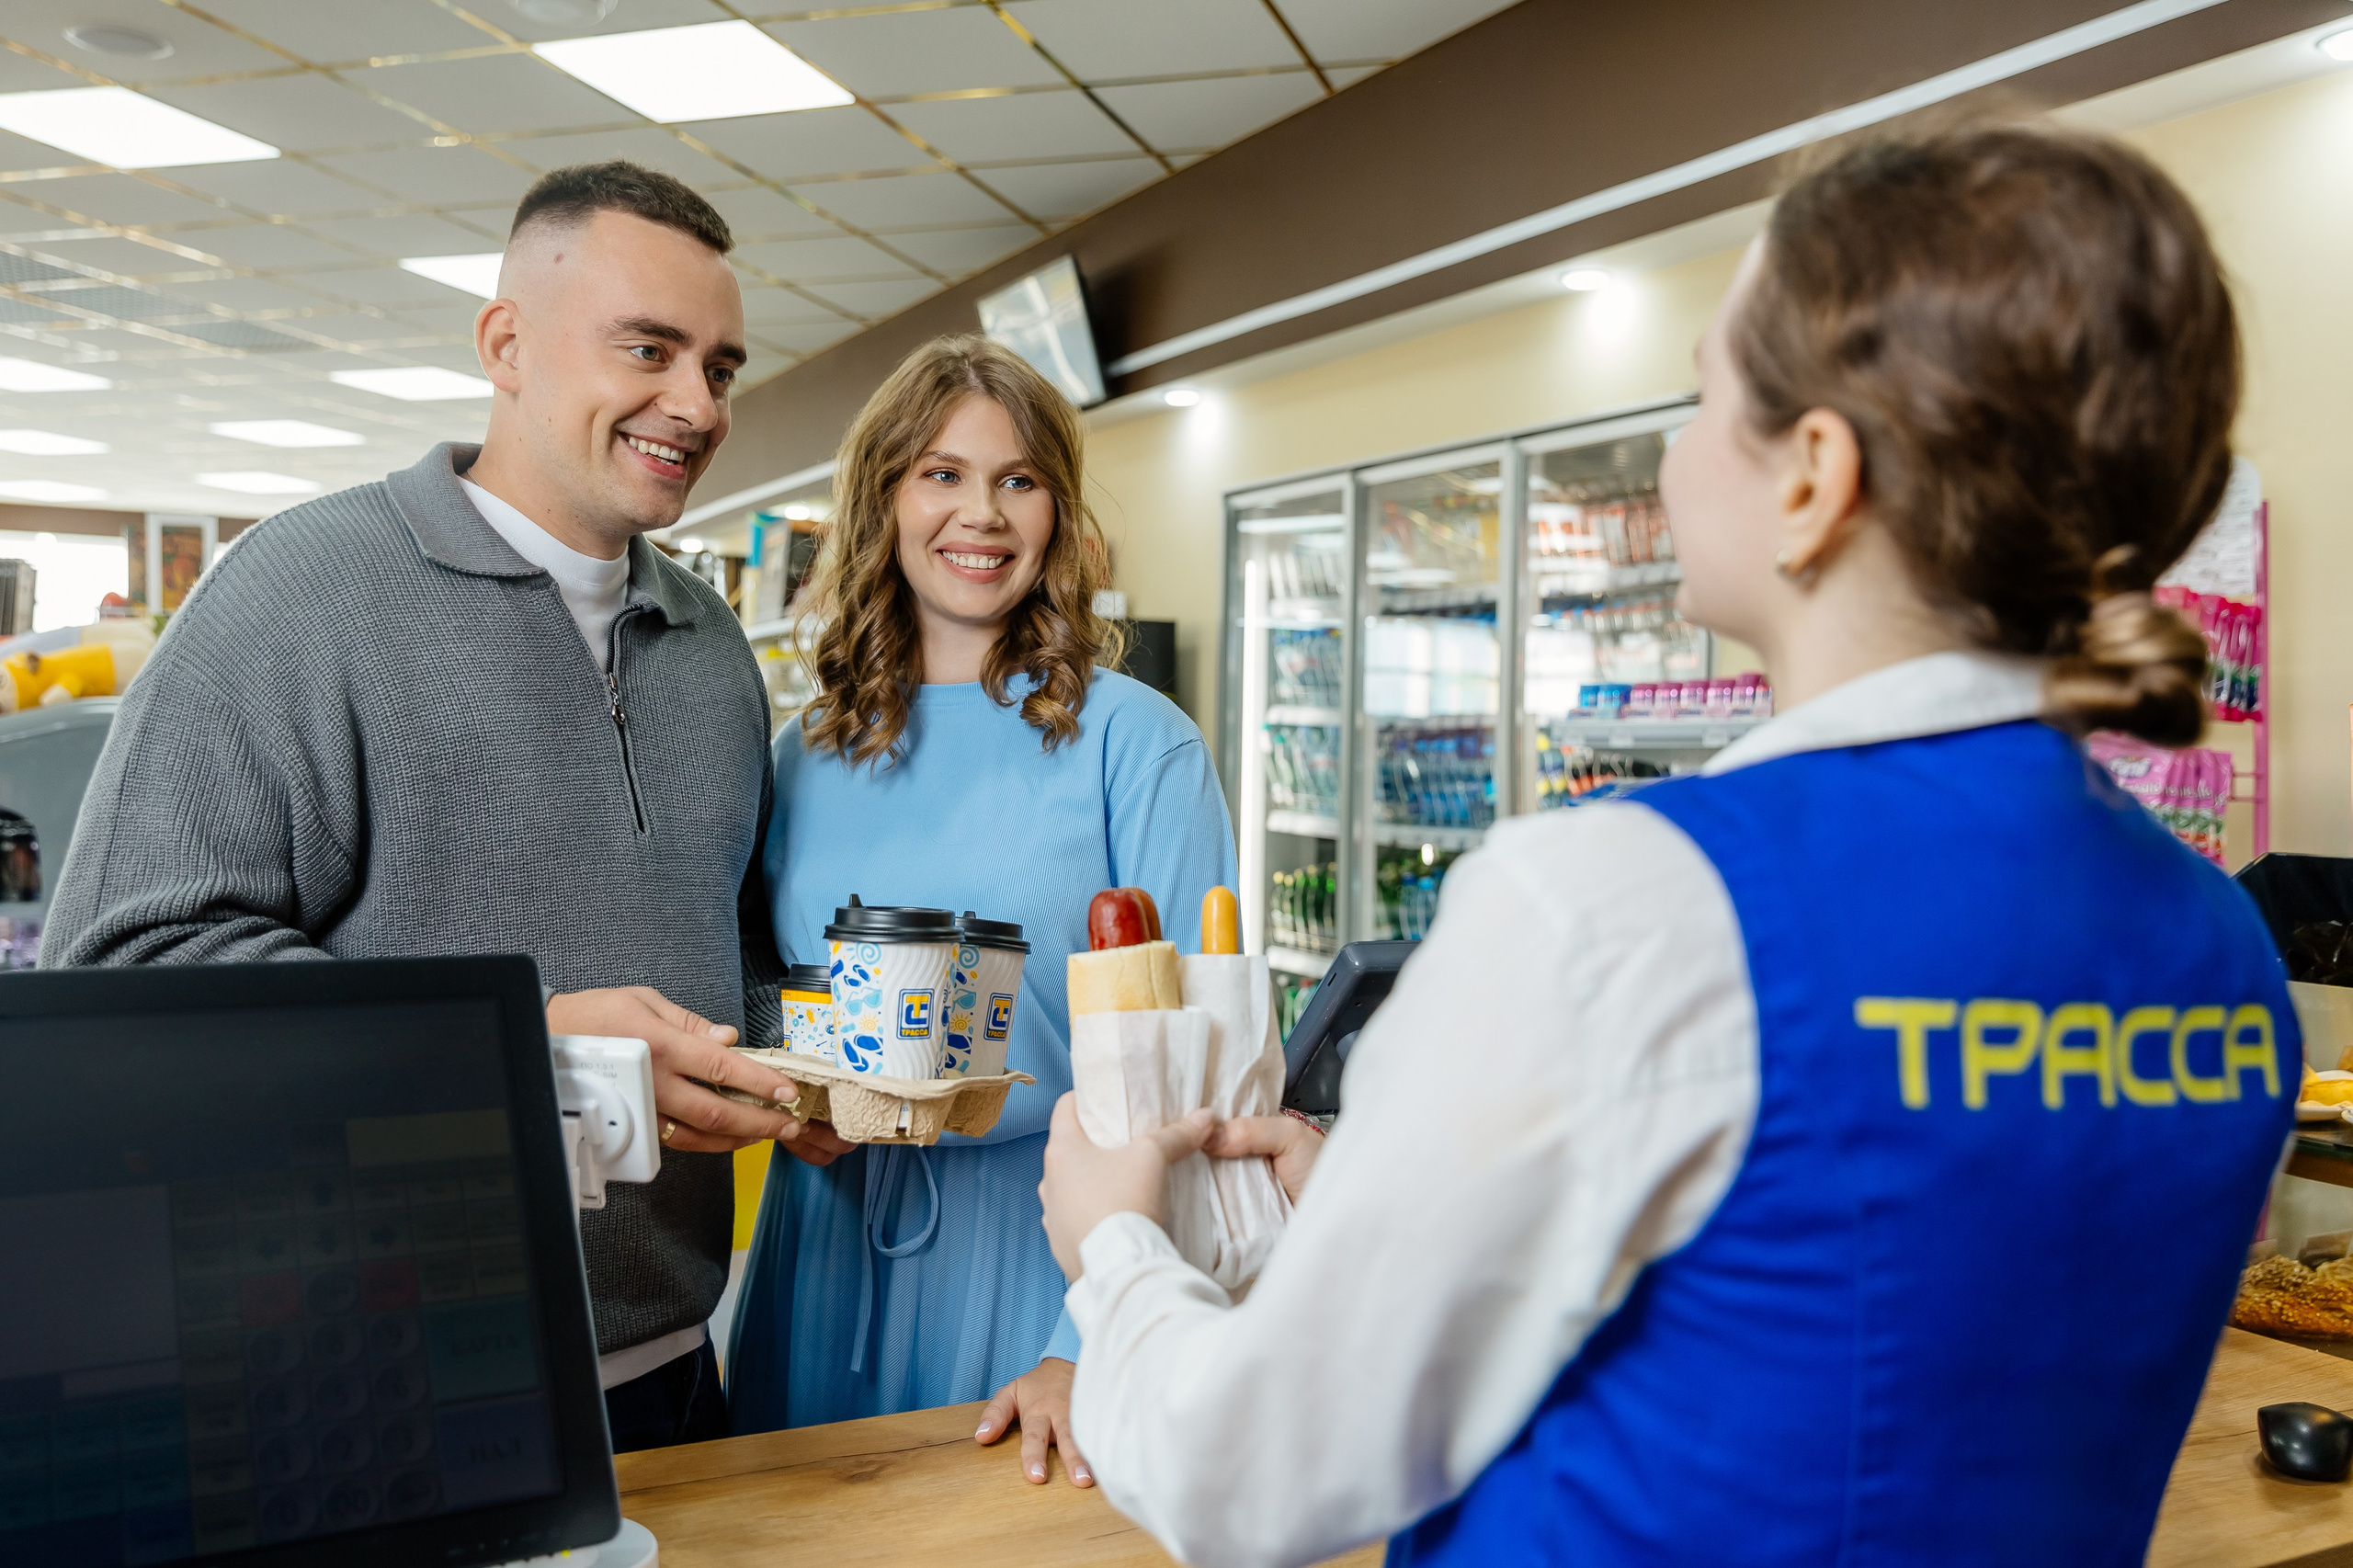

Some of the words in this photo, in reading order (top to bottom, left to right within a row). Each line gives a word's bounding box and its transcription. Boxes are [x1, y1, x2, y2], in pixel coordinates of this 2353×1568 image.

[902, 1028, 928, 1037] ТРАССА
[987, 1029, 1006, 1039] ТРАССА
[1854, 995, 2281, 1110] ТРАССА
